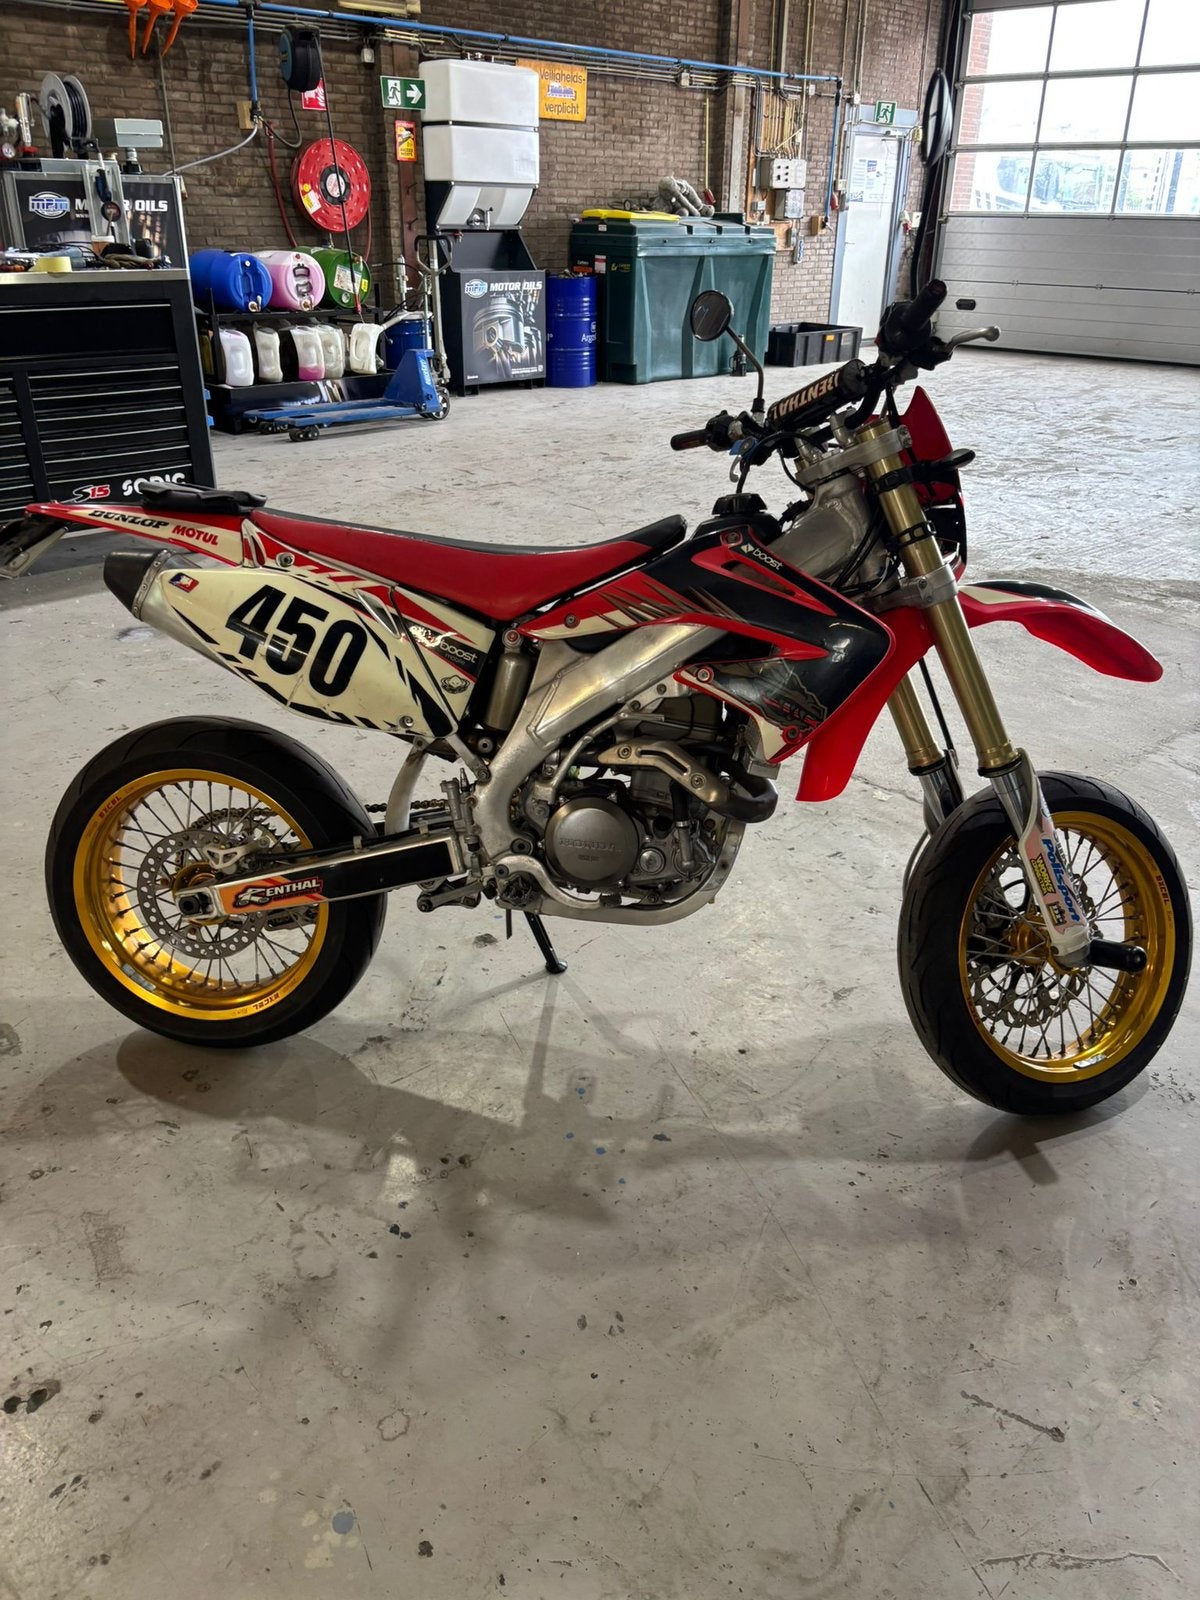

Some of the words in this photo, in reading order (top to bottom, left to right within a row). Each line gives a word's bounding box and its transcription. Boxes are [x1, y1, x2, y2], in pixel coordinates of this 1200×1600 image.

[540, 67, 586, 84] Veiligheids-
[544, 102, 580, 115] verplicht
[135, 199, 168, 212] OILS
[489, 283, 521, 292] MOTOR
[522, 281, 543, 291] OILS
[88, 510, 170, 529] DUNLOP
[172, 525, 219, 546] MOTUL
[753, 548, 783, 570] boost
[225, 584, 368, 697] 450
[440, 639, 478, 663] boost
[98, 795, 122, 819] EXCEL
[1036, 854, 1056, 894] WORKS
[1041, 838, 1081, 922] Polisport
[1155, 875, 1169, 905] EXCEL
[252, 992, 280, 1011] EXCEL
